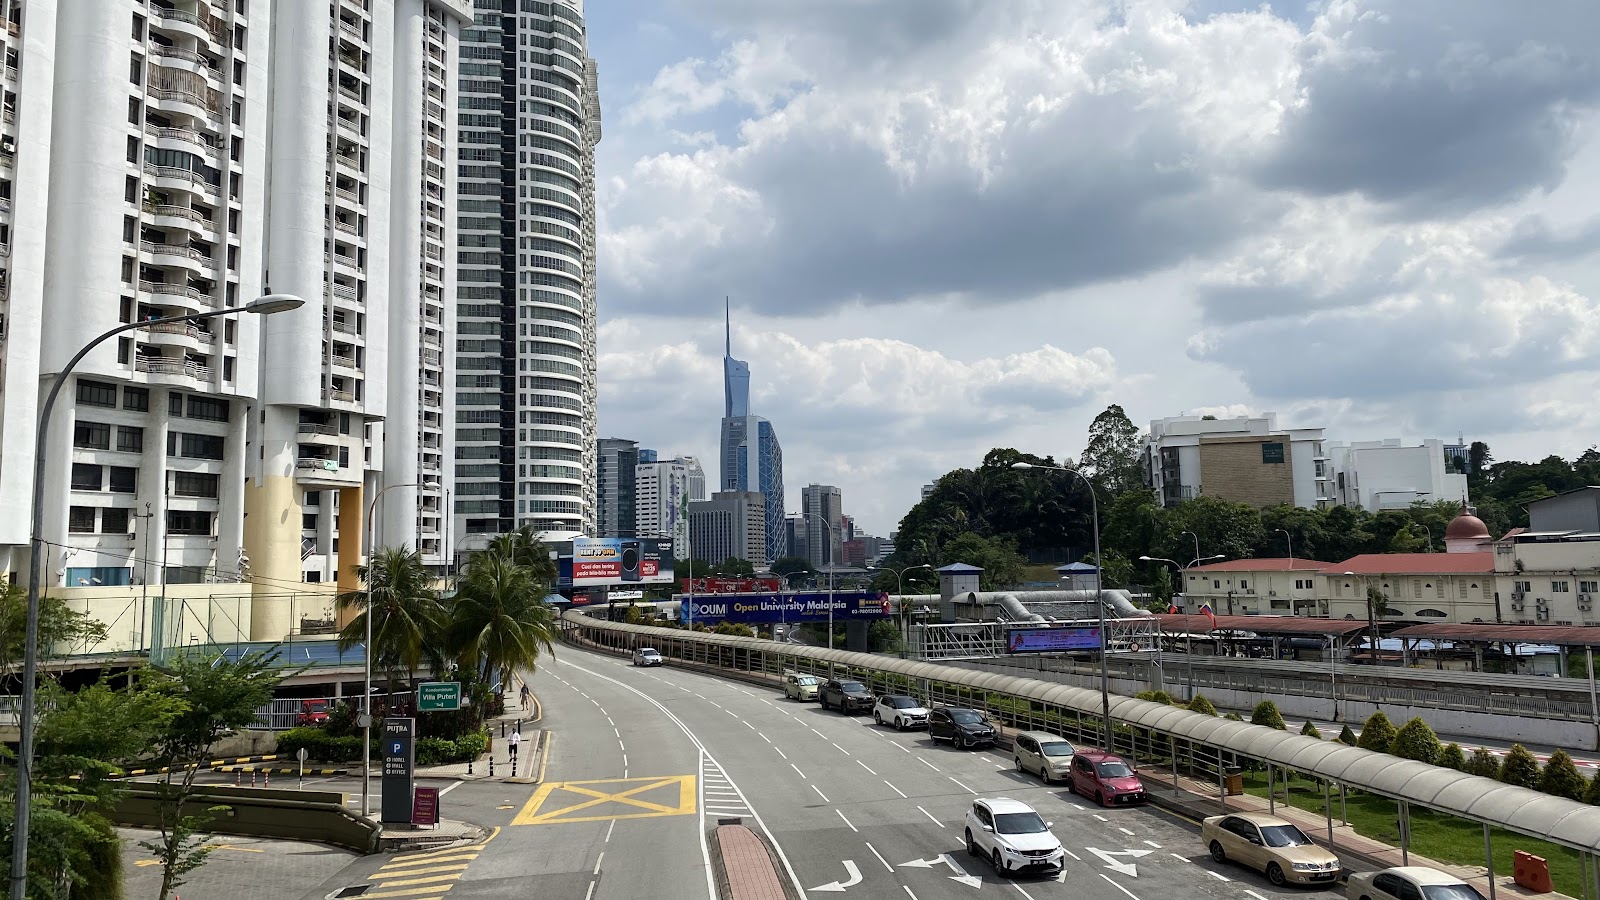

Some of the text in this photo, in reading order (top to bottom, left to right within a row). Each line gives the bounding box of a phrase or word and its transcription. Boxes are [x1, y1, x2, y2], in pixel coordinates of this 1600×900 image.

[700, 604, 726, 614] OUM
[734, 602, 758, 614] Open
[760, 602, 805, 612] University
[806, 600, 846, 610] Malaysia
[386, 726, 408, 734] PUTRA
[394, 744, 400, 753] P
